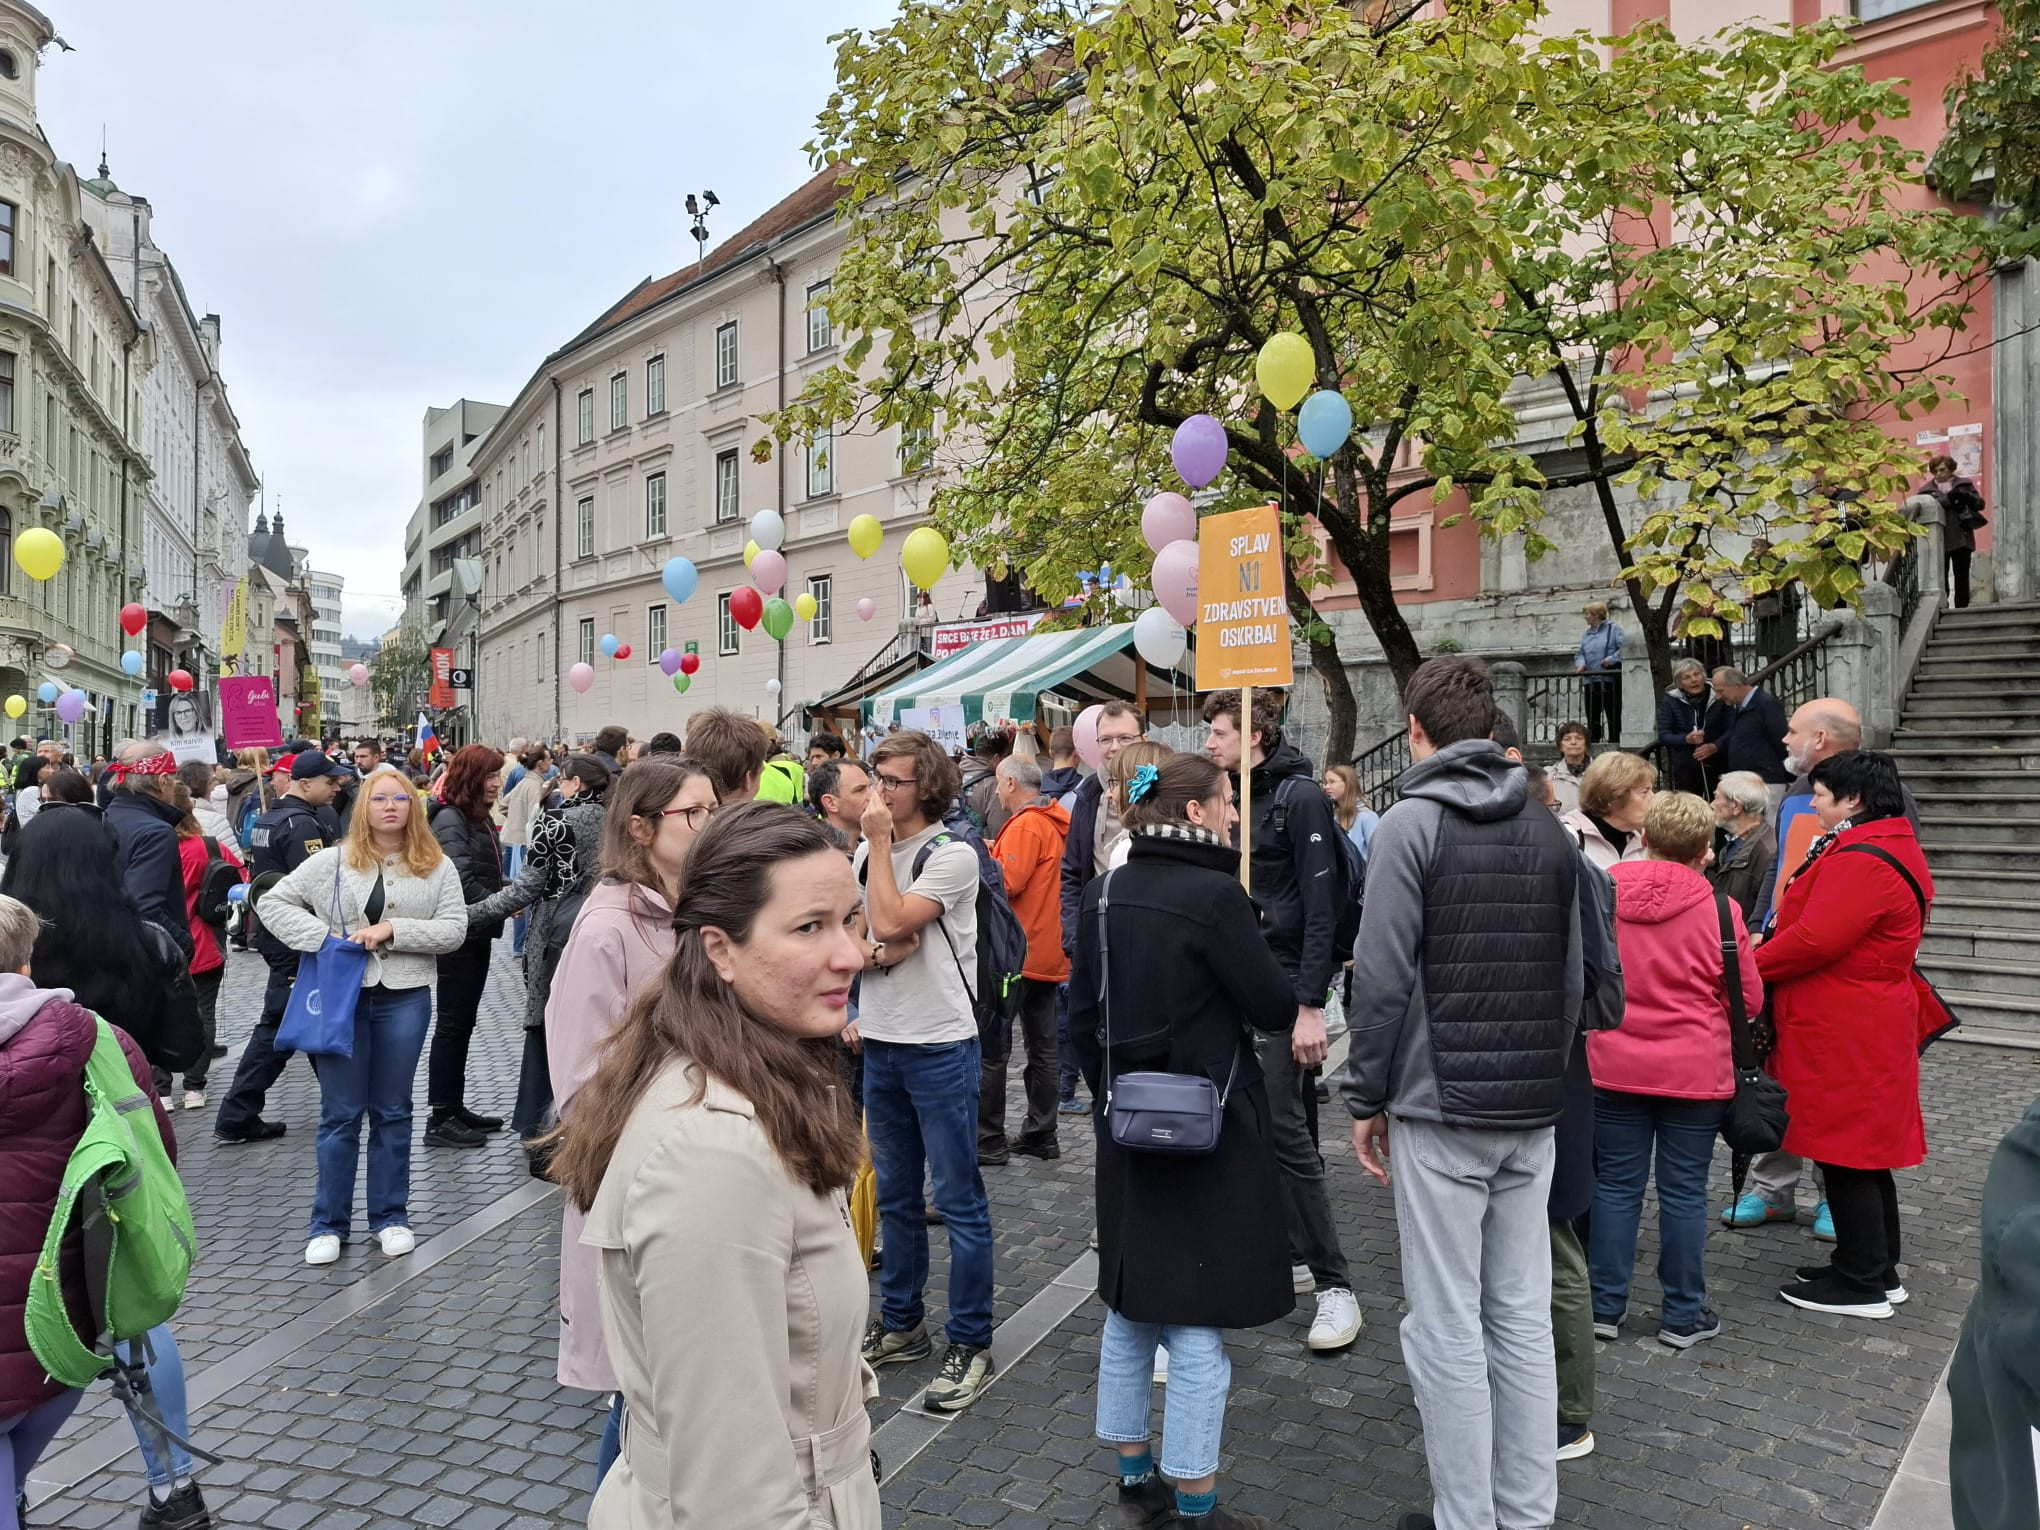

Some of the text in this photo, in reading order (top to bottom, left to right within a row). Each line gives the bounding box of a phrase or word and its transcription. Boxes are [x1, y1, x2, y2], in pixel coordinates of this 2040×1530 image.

[1230, 532, 1270, 557] SPLAV
[1239, 560, 1259, 592] NI
[937, 632, 959, 644] SRCE
[1000, 623, 1026, 638] DAN
[1220, 624, 1277, 648] OSKRBA!
